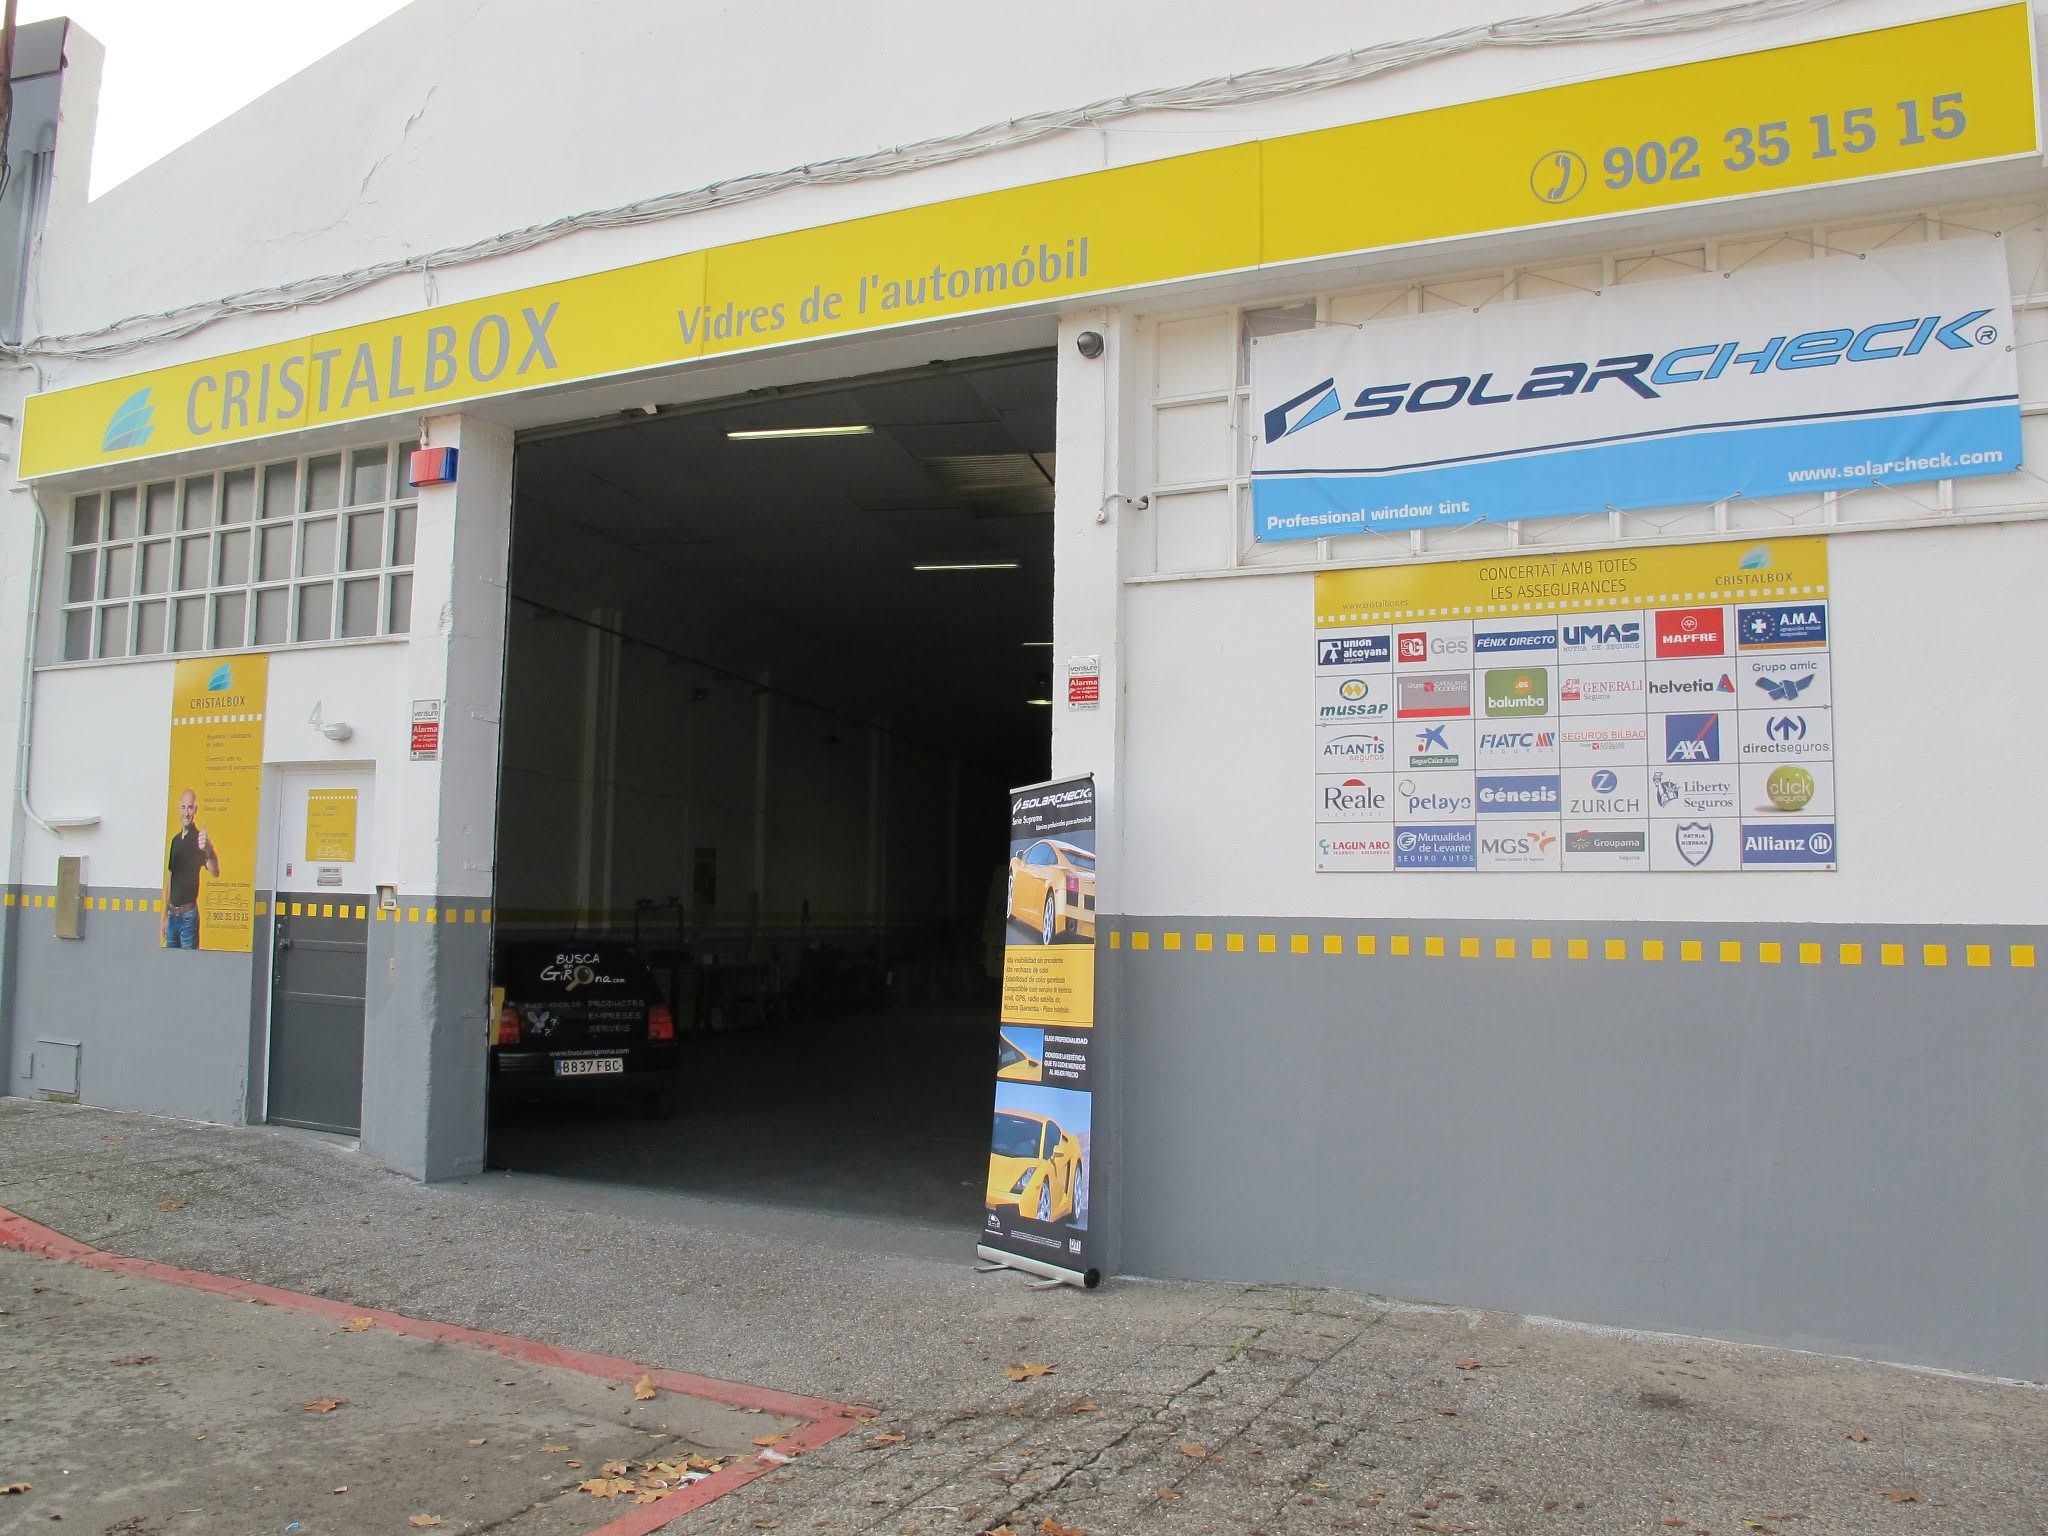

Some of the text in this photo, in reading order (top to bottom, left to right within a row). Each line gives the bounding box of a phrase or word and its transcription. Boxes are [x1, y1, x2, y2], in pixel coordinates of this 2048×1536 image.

[1603, 92, 1967, 190] 902 35 15 15
[678, 236, 1089, 345] Vidres de l'automóbil
[187, 302, 560, 436] CRISTALBOX
[1788, 450, 2003, 482] www.solarcheck.com
[1268, 500, 1470, 529] Professional window tint
[1479, 557, 1637, 581] CONCERTAT AMB TOTES
[1715, 572, 1793, 586] CRISTALBOX
[1491, 578, 1626, 600] LES ASSEGURANCES
[1342, 599, 1408, 610] www.cristalbox.es
[1780, 612, 1821, 625] A.M.A.
[1562, 622, 1640, 645] UMAS
[1662, 632, 1718, 644] MAPFRE
[1343, 639, 1372, 648] unión
[1430, 637, 1468, 655] Ges
[1476, 635, 1555, 648] FÉNIX DIRECTO
[1343, 647, 1388, 659] alcoyana
[1752, 661, 1817, 673] Grupo amic
[1070, 679, 1098, 687] Alarma
[1583, 680, 1643, 693] GENERALI
[1649, 679, 1714, 694] helvetia
[190, 696, 246, 709] CRISTALBOX
[1488, 696, 1545, 709] balumba
[1583, 693, 1611, 701] Seguros
[1319, 703, 1389, 717] mussap
[413, 725, 438, 733] Alarma
[1561, 730, 1646, 741] SEGUROS BILBAO
[1479, 732, 1533, 749] FIATC
[1323, 743, 1385, 755] ATLANTIS
[1667, 740, 1710, 760] AXA
[1743, 742, 1829, 755] directseguros
[1348, 754, 1385, 763] seguros
[1684, 781, 1731, 796] Liberty
[1769, 777, 1811, 795] click
[1324, 786, 1385, 811] Reale
[1479, 785, 1557, 803] Génesis
[1409, 793, 1471, 814] pelayo
[1570, 799, 1640, 813] ZURICH
[1683, 797, 1734, 811] Seguros
[1417, 832, 1471, 842] Mutualidad
[1593, 838, 1640, 848] Groupama
[1744, 836, 1805, 851] Allianz
[1332, 840, 1390, 850] LAGUN ARO
[1419, 843, 1471, 853] de Levante
[1481, 838, 1530, 855] MGS
[556, 954, 600, 964] BUSCA
[587, 999, 646, 1008] PRODUCTES
[549, 1048, 630, 1057] www.buscaengirona.com
[562, 1060, 620, 1074] 8837 FBC
